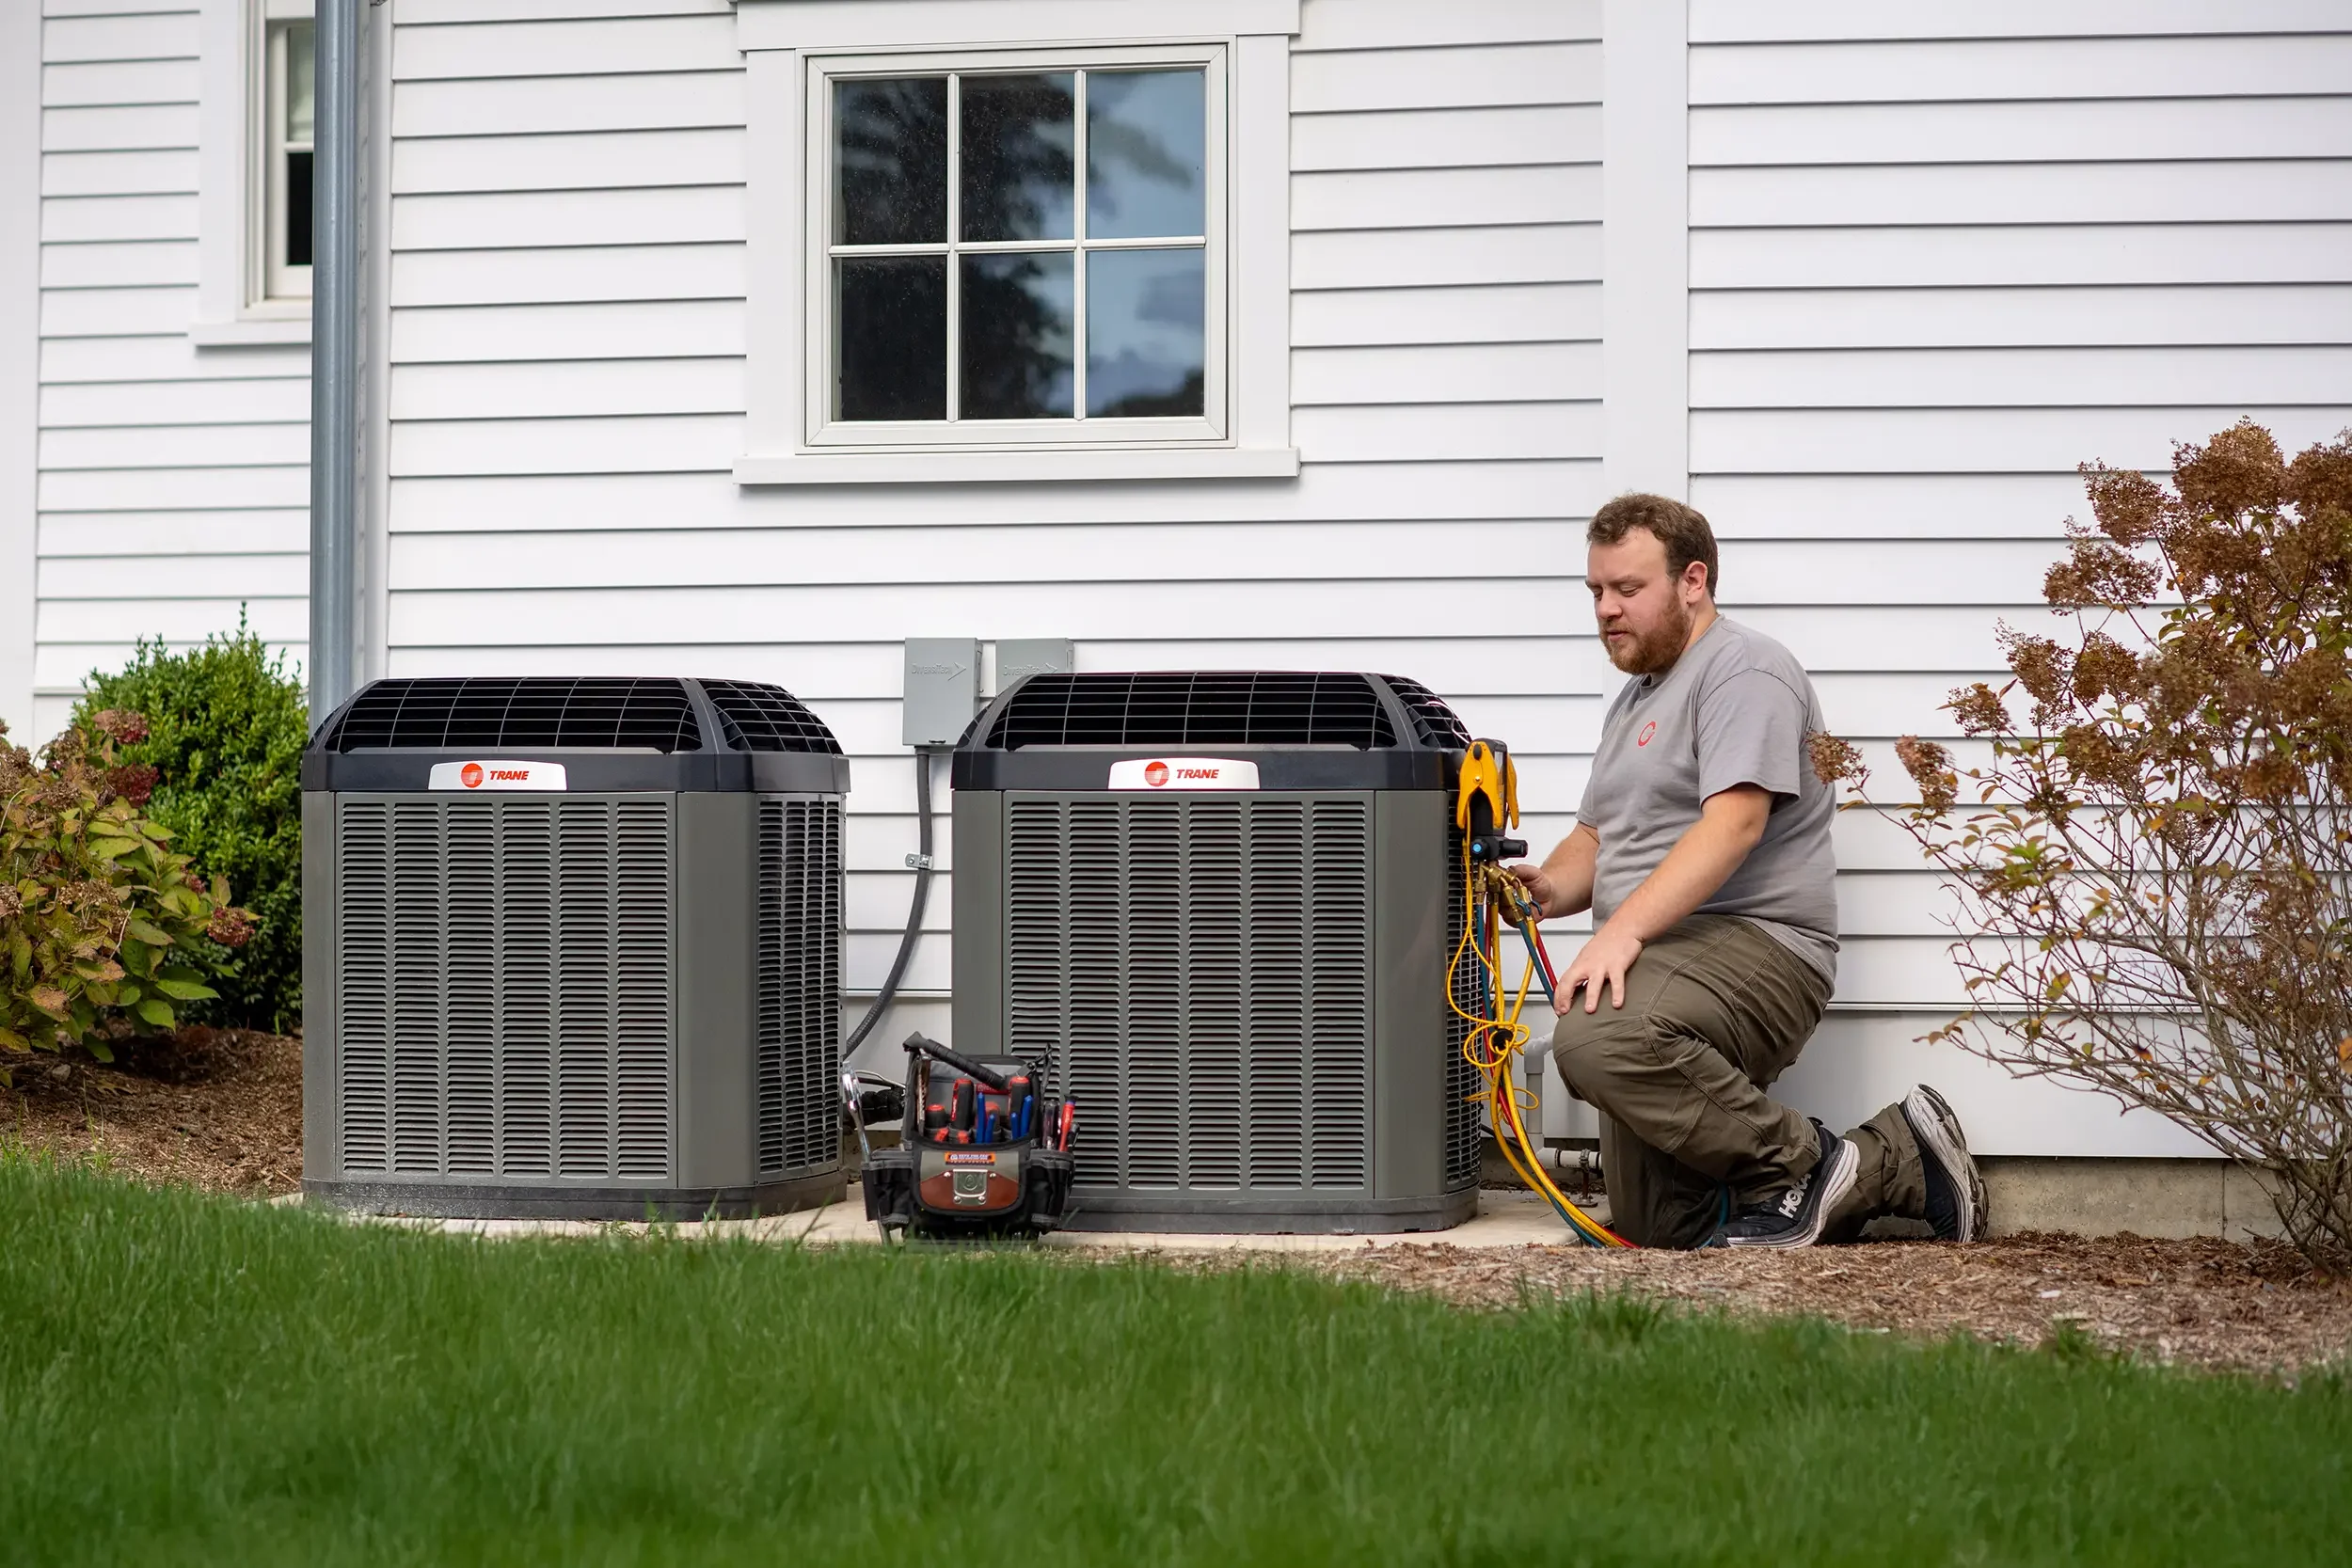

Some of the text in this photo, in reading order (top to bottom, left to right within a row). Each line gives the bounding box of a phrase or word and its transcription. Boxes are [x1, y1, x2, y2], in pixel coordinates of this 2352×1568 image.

[489, 770, 530, 781] TRANE
[1176, 768, 1219, 779] TRANE
[1778, 1173, 1811, 1218] HOKA
